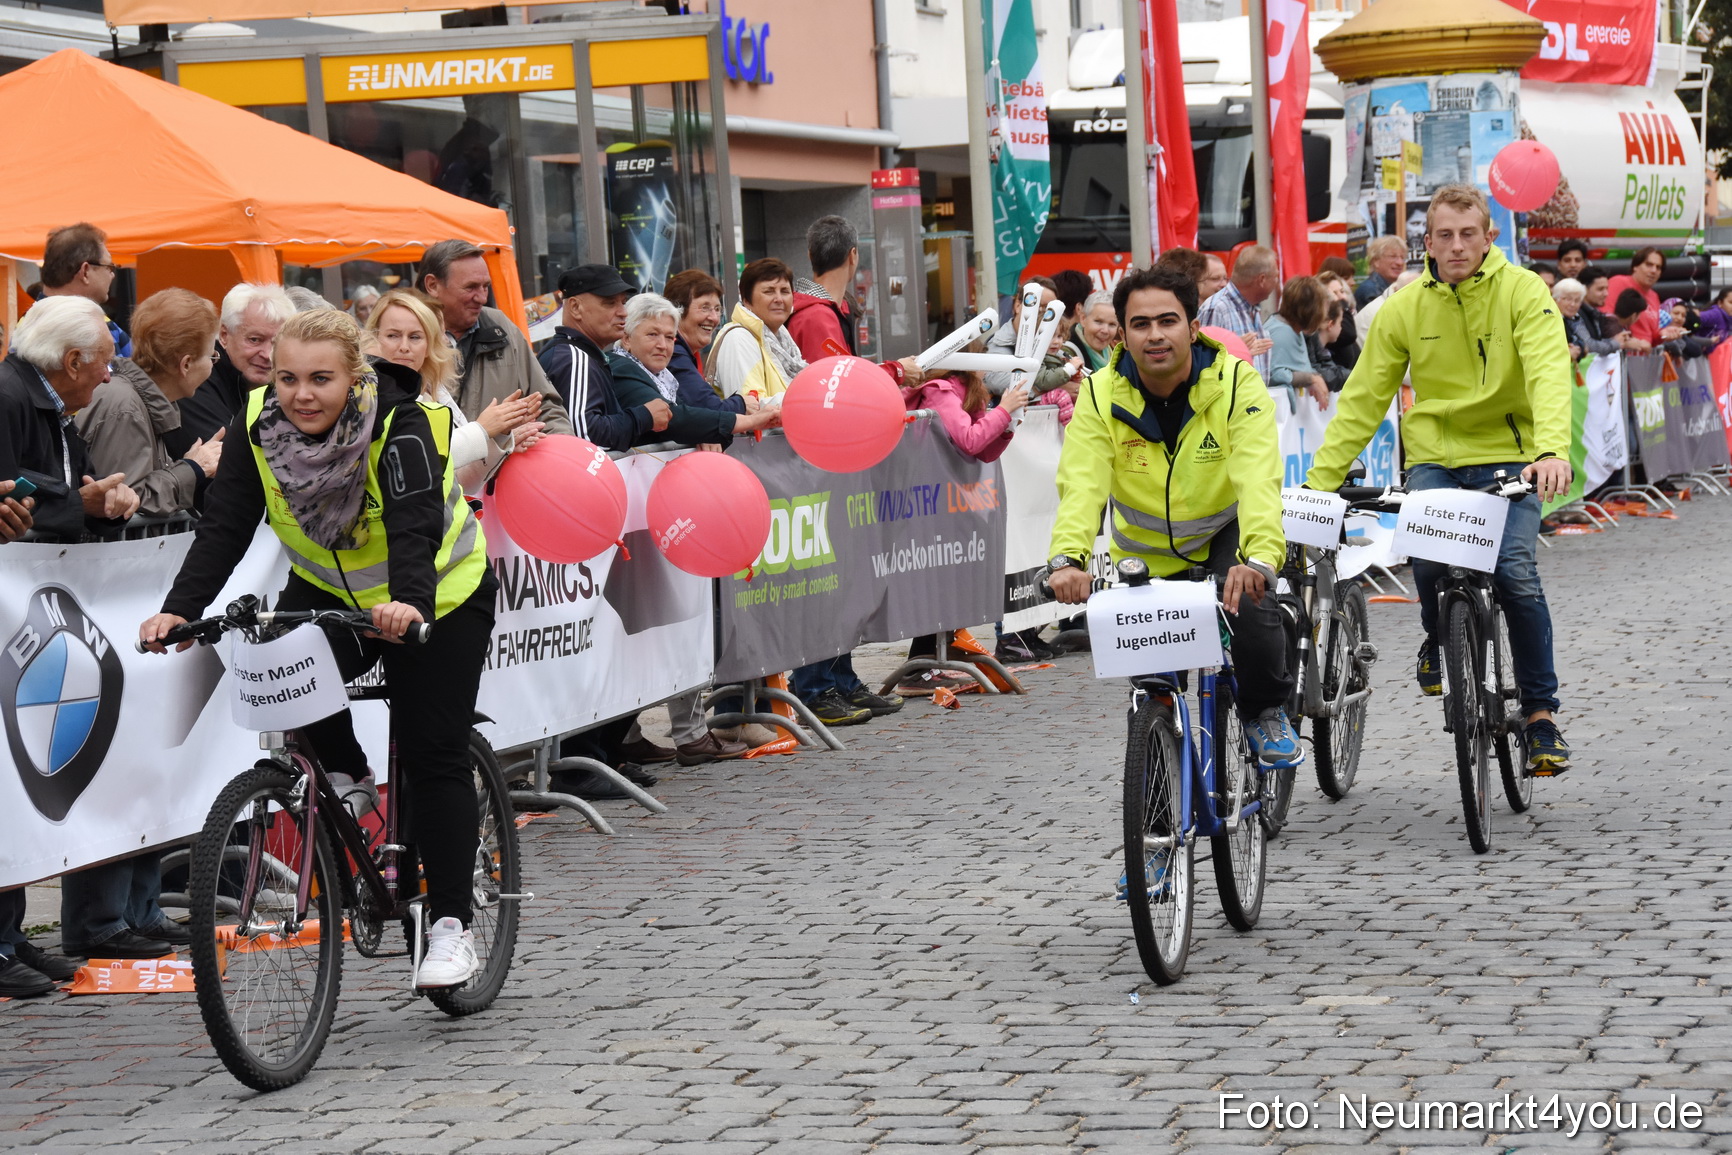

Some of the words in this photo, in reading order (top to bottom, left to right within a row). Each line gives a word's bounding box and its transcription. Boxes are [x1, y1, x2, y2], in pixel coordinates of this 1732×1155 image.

[348, 57, 554, 91] RUNMARKT.DE
[1436, 87, 1475, 99] CHRISTIAN
[1436, 99, 1473, 110] SPRINGER
[1618, 100, 1687, 166] AVIA
[629, 158, 655, 172] cep
[1620, 173, 1687, 220] Pellets
[1297, 494, 1332, 506] Mann
[1424, 505, 1456, 523] Erste
[1458, 510, 1487, 527] Frau
[674, 523, 697, 545] energie
[752, 501, 831, 567] OCK
[1406, 522, 1494, 549] Halbmarathon
[494, 555, 600, 613] NAMICS.
[770, 581, 781, 607] by
[783, 578, 807, 600] smart
[1116, 610, 1153, 626] Erste
[1157, 606, 1190, 622] Frau
[7, 593, 110, 669] BMW
[1116, 628, 1196, 651] Jugendlauf
[267, 656, 316, 681] Mann
[239, 677, 317, 707] Jugendlauf
